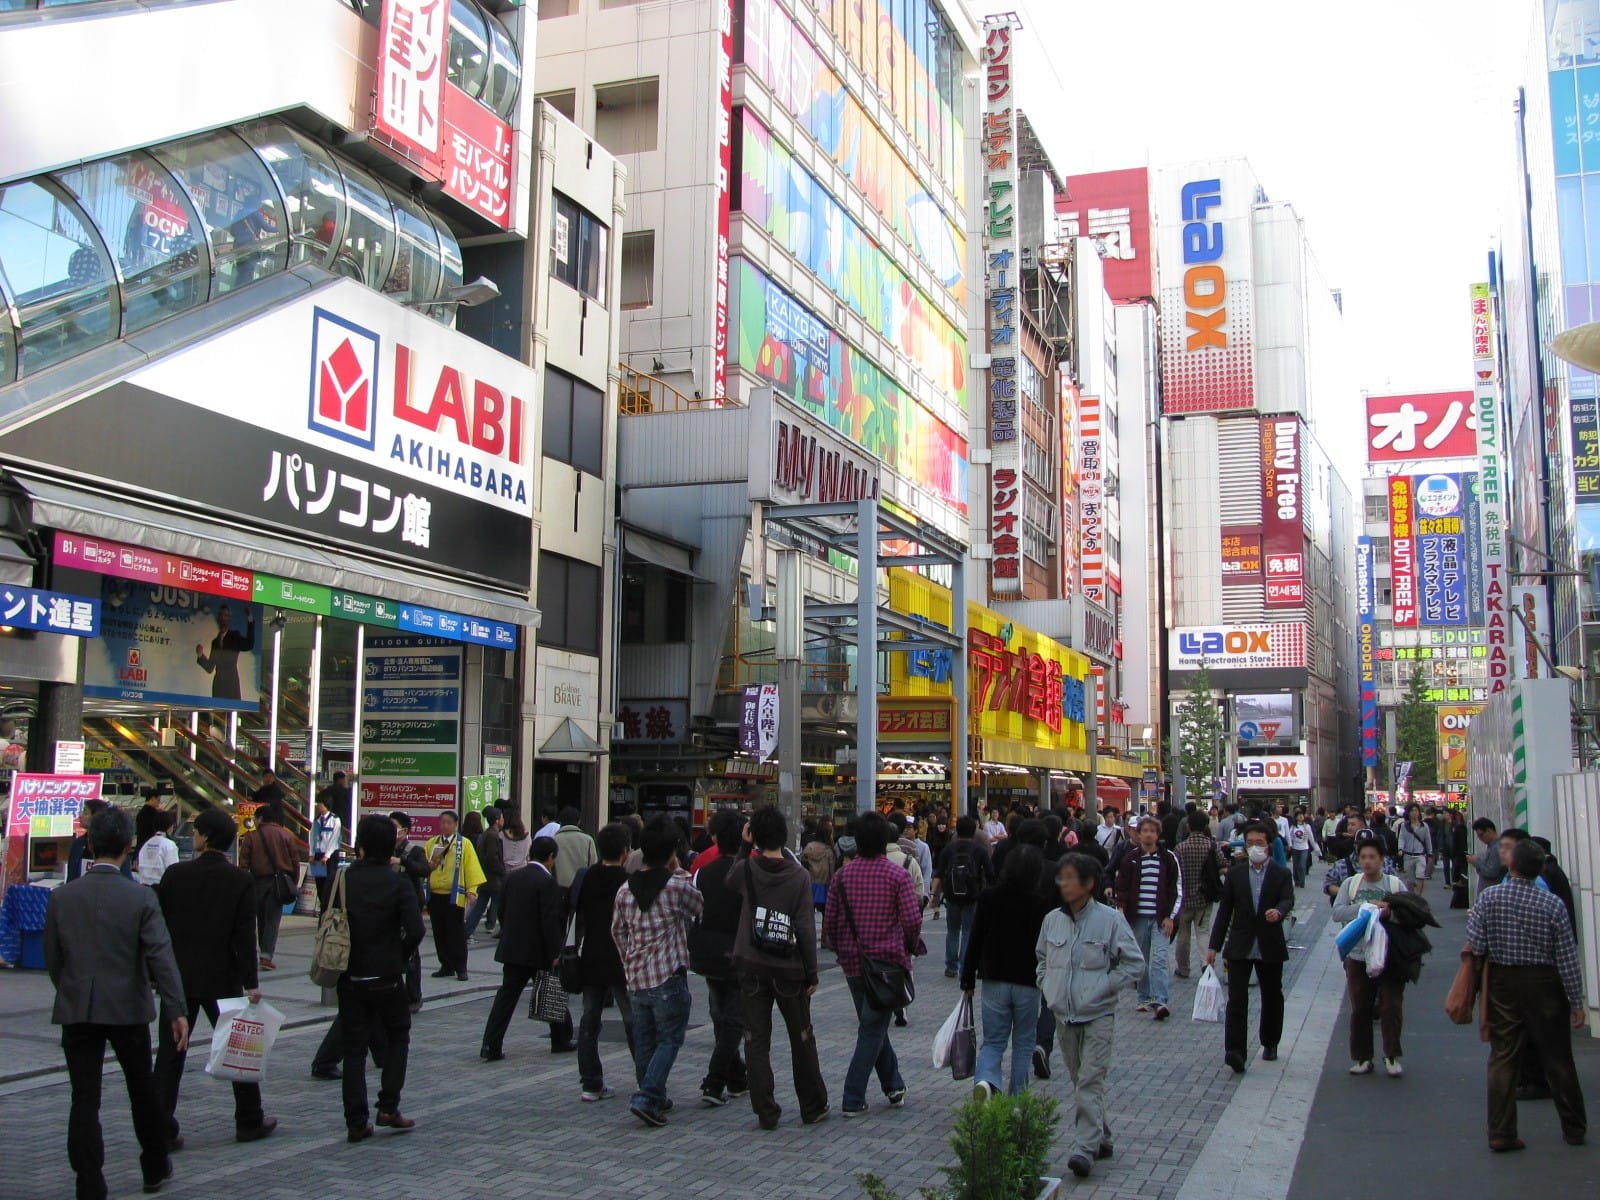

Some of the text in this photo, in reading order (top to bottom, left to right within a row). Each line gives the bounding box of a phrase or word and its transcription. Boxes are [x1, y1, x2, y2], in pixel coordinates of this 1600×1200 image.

[452, 133, 508, 190] モバイル
[450, 167, 508, 217] パソコン
[771, 294, 826, 350] KAIYODO
[986, 26, 1019, 578] パソコン ビデオ テレビ オーディオ 電化製品 ラジオ会館
[1473, 298, 1489, 354] まんが喫茶
[393, 341, 525, 465] LABI
[1480, 397, 1496, 448] DUTY
[390, 432, 527, 505] AKIHABARA
[1083, 440, 1098, 480] 買取り
[1264, 423, 1275, 497] Flagship Store
[1482, 455, 1499, 504] FREE
[262, 448, 433, 549] パソコン館
[1084, 502, 1098, 551] まっくす
[1222, 536, 1240, 546] 本店
[1485, 511, 1500, 557] 免税店
[1268, 558, 1299, 573] 免税
[1393, 539, 1411, 573] DUTY
[1442, 538, 1460, 620] 液晶テレビ
[3, 590, 93, 632] ント進呈
[1358, 544, 1373, 681] Panasonic ONODEN
[1395, 574, 1412, 606] FREE
[1486, 564, 1507, 694] TAKARADA
[119, 667, 148, 682] LABI
[968, 627, 1062, 735] ラジオ会館
[1203, 655, 1248, 665] Electronics
[1249, 655, 1271, 663] Store
[554, 686, 582, 706] BRAVE
[763, 687, 776, 695] 祝
[761, 698, 775, 741] 天皇陛下
[879, 710, 948, 732] ラジオ会館
